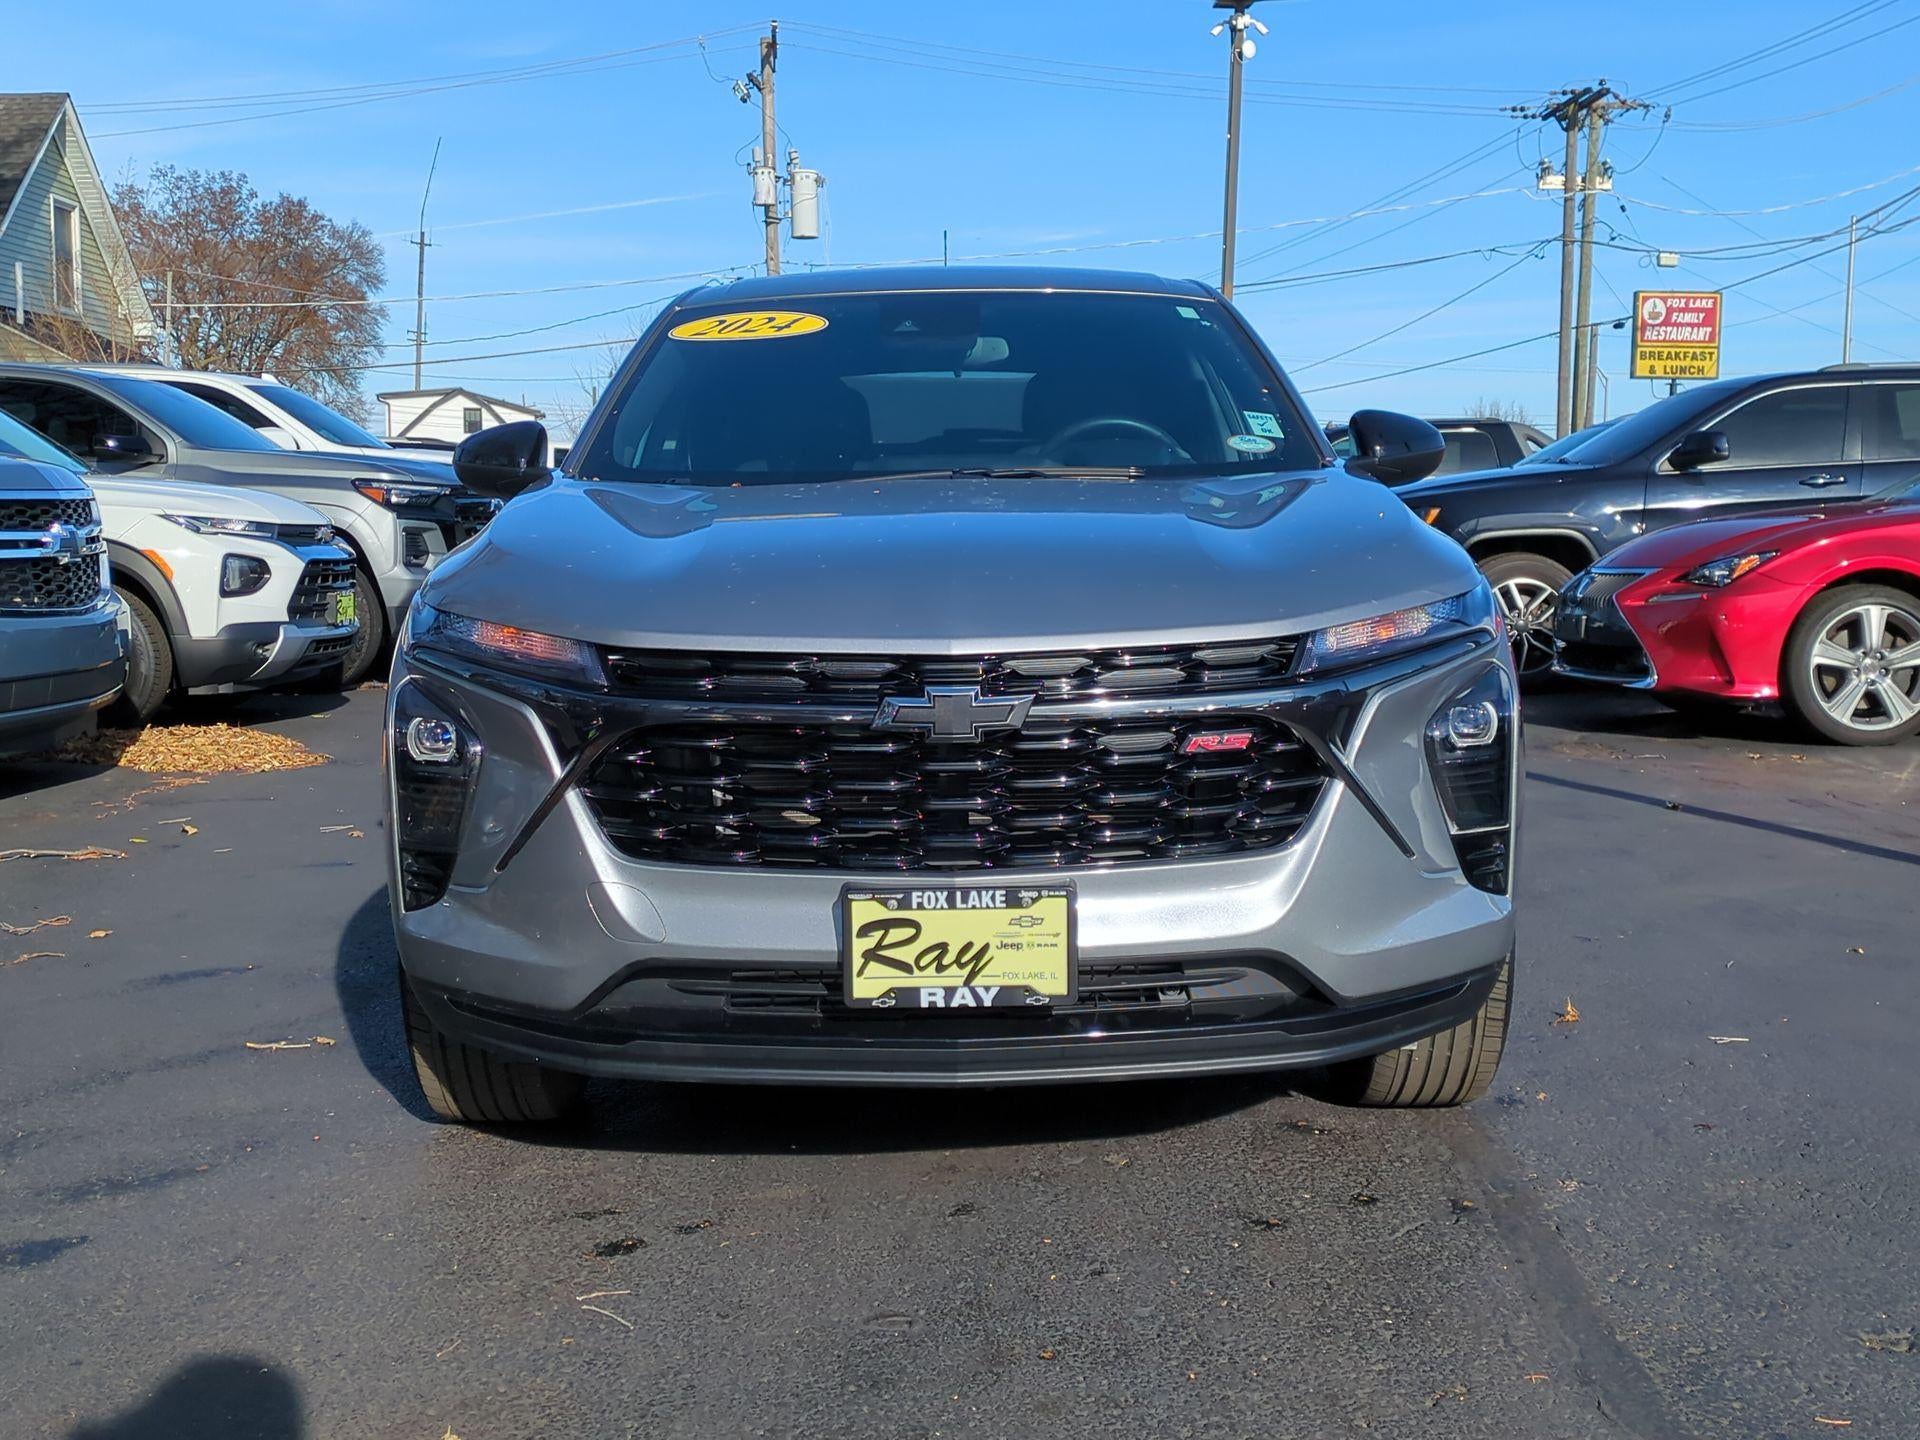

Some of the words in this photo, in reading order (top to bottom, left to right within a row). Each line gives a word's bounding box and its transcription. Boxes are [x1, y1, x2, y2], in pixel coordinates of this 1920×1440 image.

[1667, 298, 1686, 308] FOX
[1689, 298, 1715, 308] LAKE
[1671, 312, 1705, 323] FAMILY
[688, 317, 806, 337] 2024
[1644, 325, 1712, 341] RESTAURANT
[1640, 350, 1715, 361] BREAKFAST
[1648, 364, 1656, 374] &
[1663, 364, 1705, 375] LUNCH
[1186, 733, 1253, 752] RS
[911, 891, 949, 909] FOX
[956, 890, 1006, 909] LAKE
[1018, 890, 1039, 899] Jeep
[856, 917, 994, 986] Ray
[996, 940, 1024, 952] Jeep
[1002, 971, 1019, 980] FOX
[1022, 971, 1048, 981] LAKE,
[1051, 971, 1058, 980] IL
[919, 986, 1000, 1008] RAY
